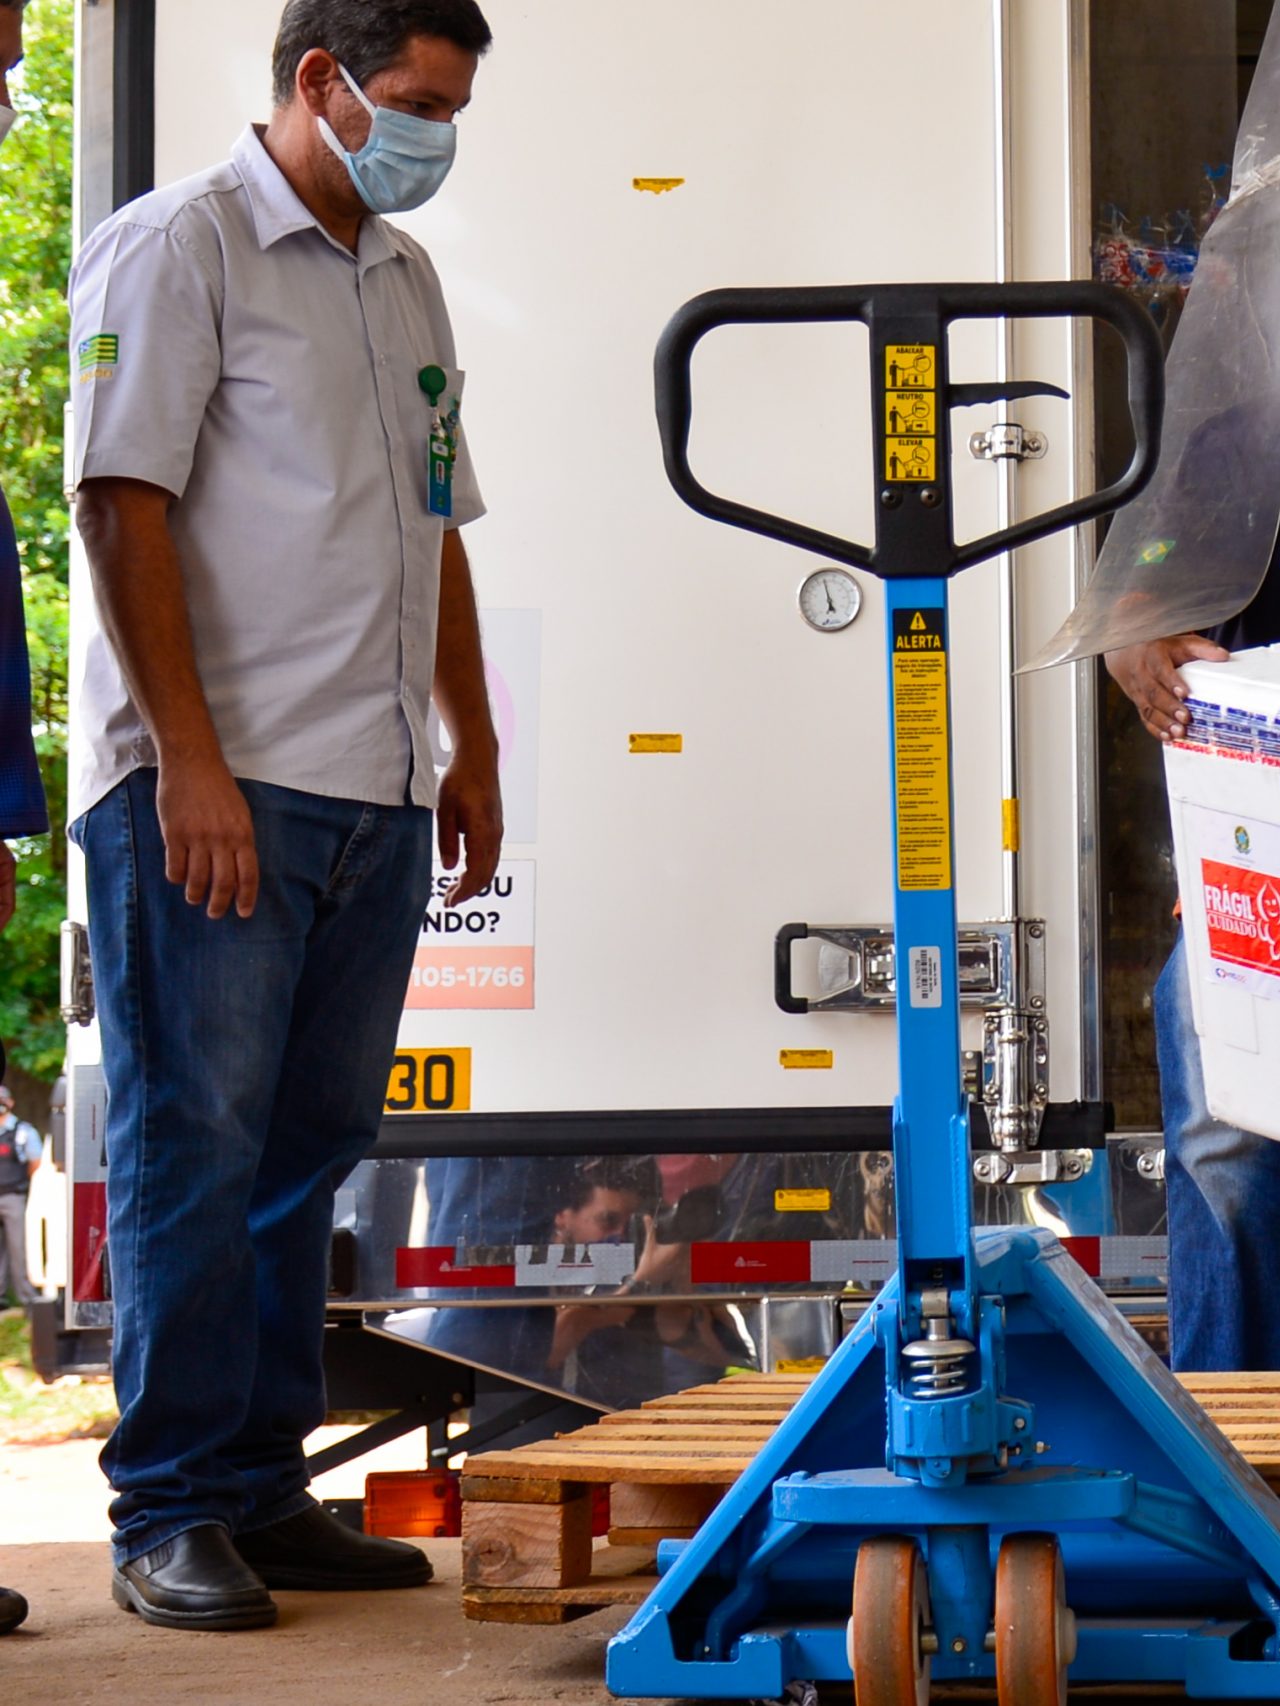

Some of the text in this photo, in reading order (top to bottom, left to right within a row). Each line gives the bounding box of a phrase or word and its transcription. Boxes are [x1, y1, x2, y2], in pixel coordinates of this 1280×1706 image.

[896, 635, 941, 649] ALERTA
[1204, 883, 1256, 921] FRÁGIL
[1207, 913, 1257, 939] CUIDADO
